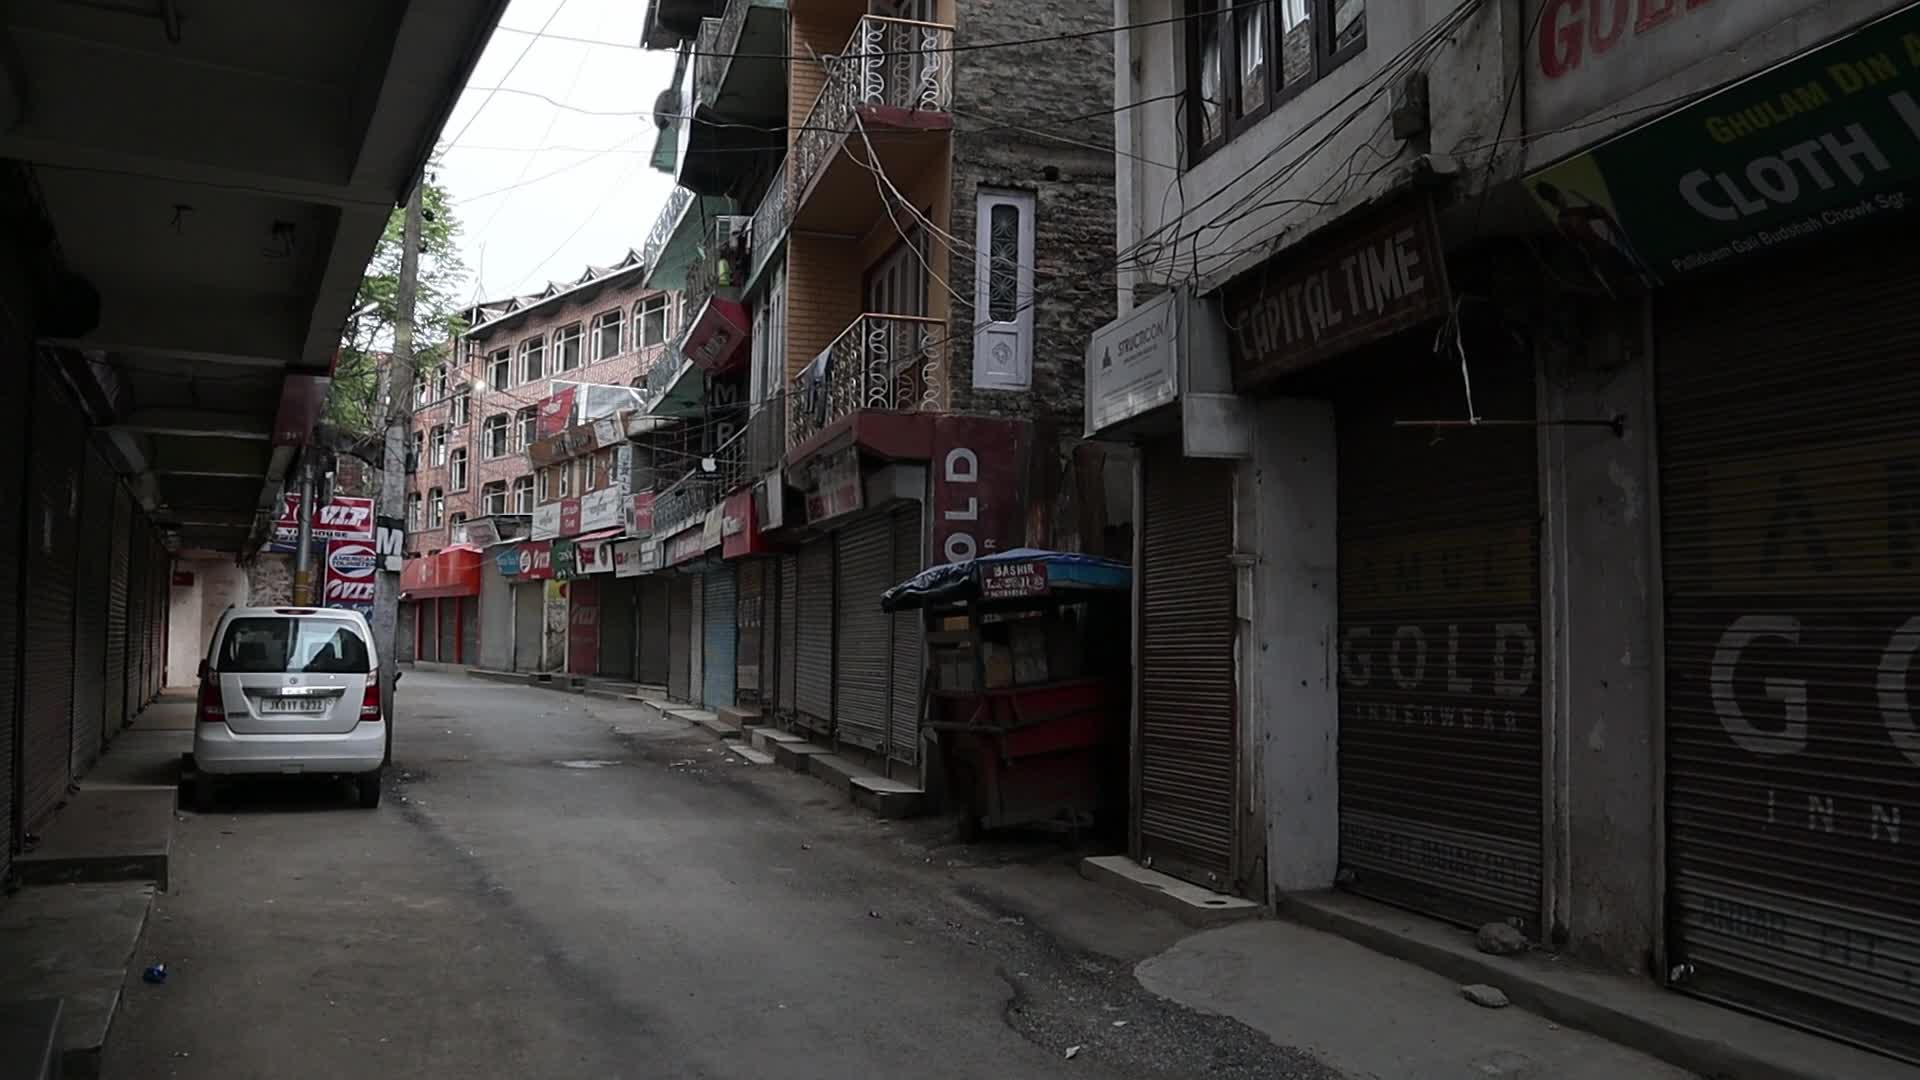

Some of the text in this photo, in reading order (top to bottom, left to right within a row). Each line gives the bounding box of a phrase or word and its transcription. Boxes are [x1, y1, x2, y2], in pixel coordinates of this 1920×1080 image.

[1704, 80, 1831, 145] GHULAM
[1826, 52, 1898, 96] DIN
[1678, 121, 1892, 222] CLOTH
[1822, 199, 1874, 226] Chowk
[1237, 228, 1426, 362] CAPITAL TIME
[1341, 622, 1537, 696] GOLD
